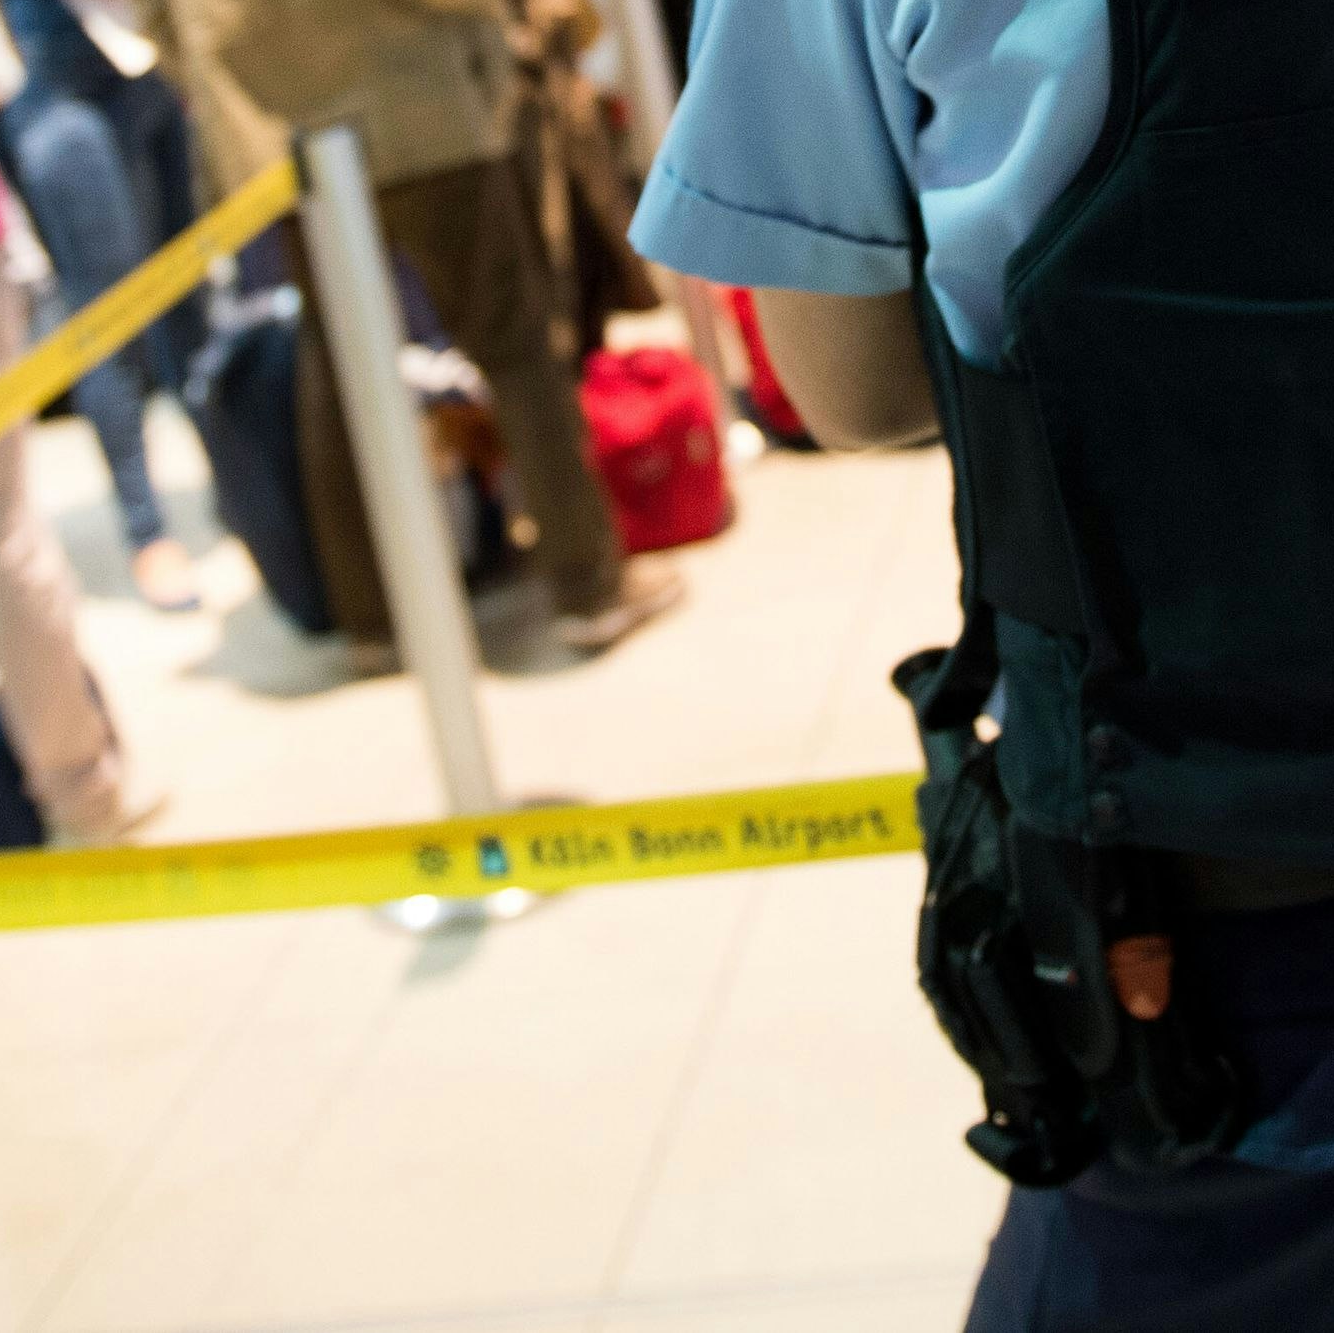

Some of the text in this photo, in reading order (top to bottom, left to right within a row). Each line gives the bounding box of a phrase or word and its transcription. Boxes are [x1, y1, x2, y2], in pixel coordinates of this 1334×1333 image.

[528, 806, 894, 868] Köln Bonn Airport
